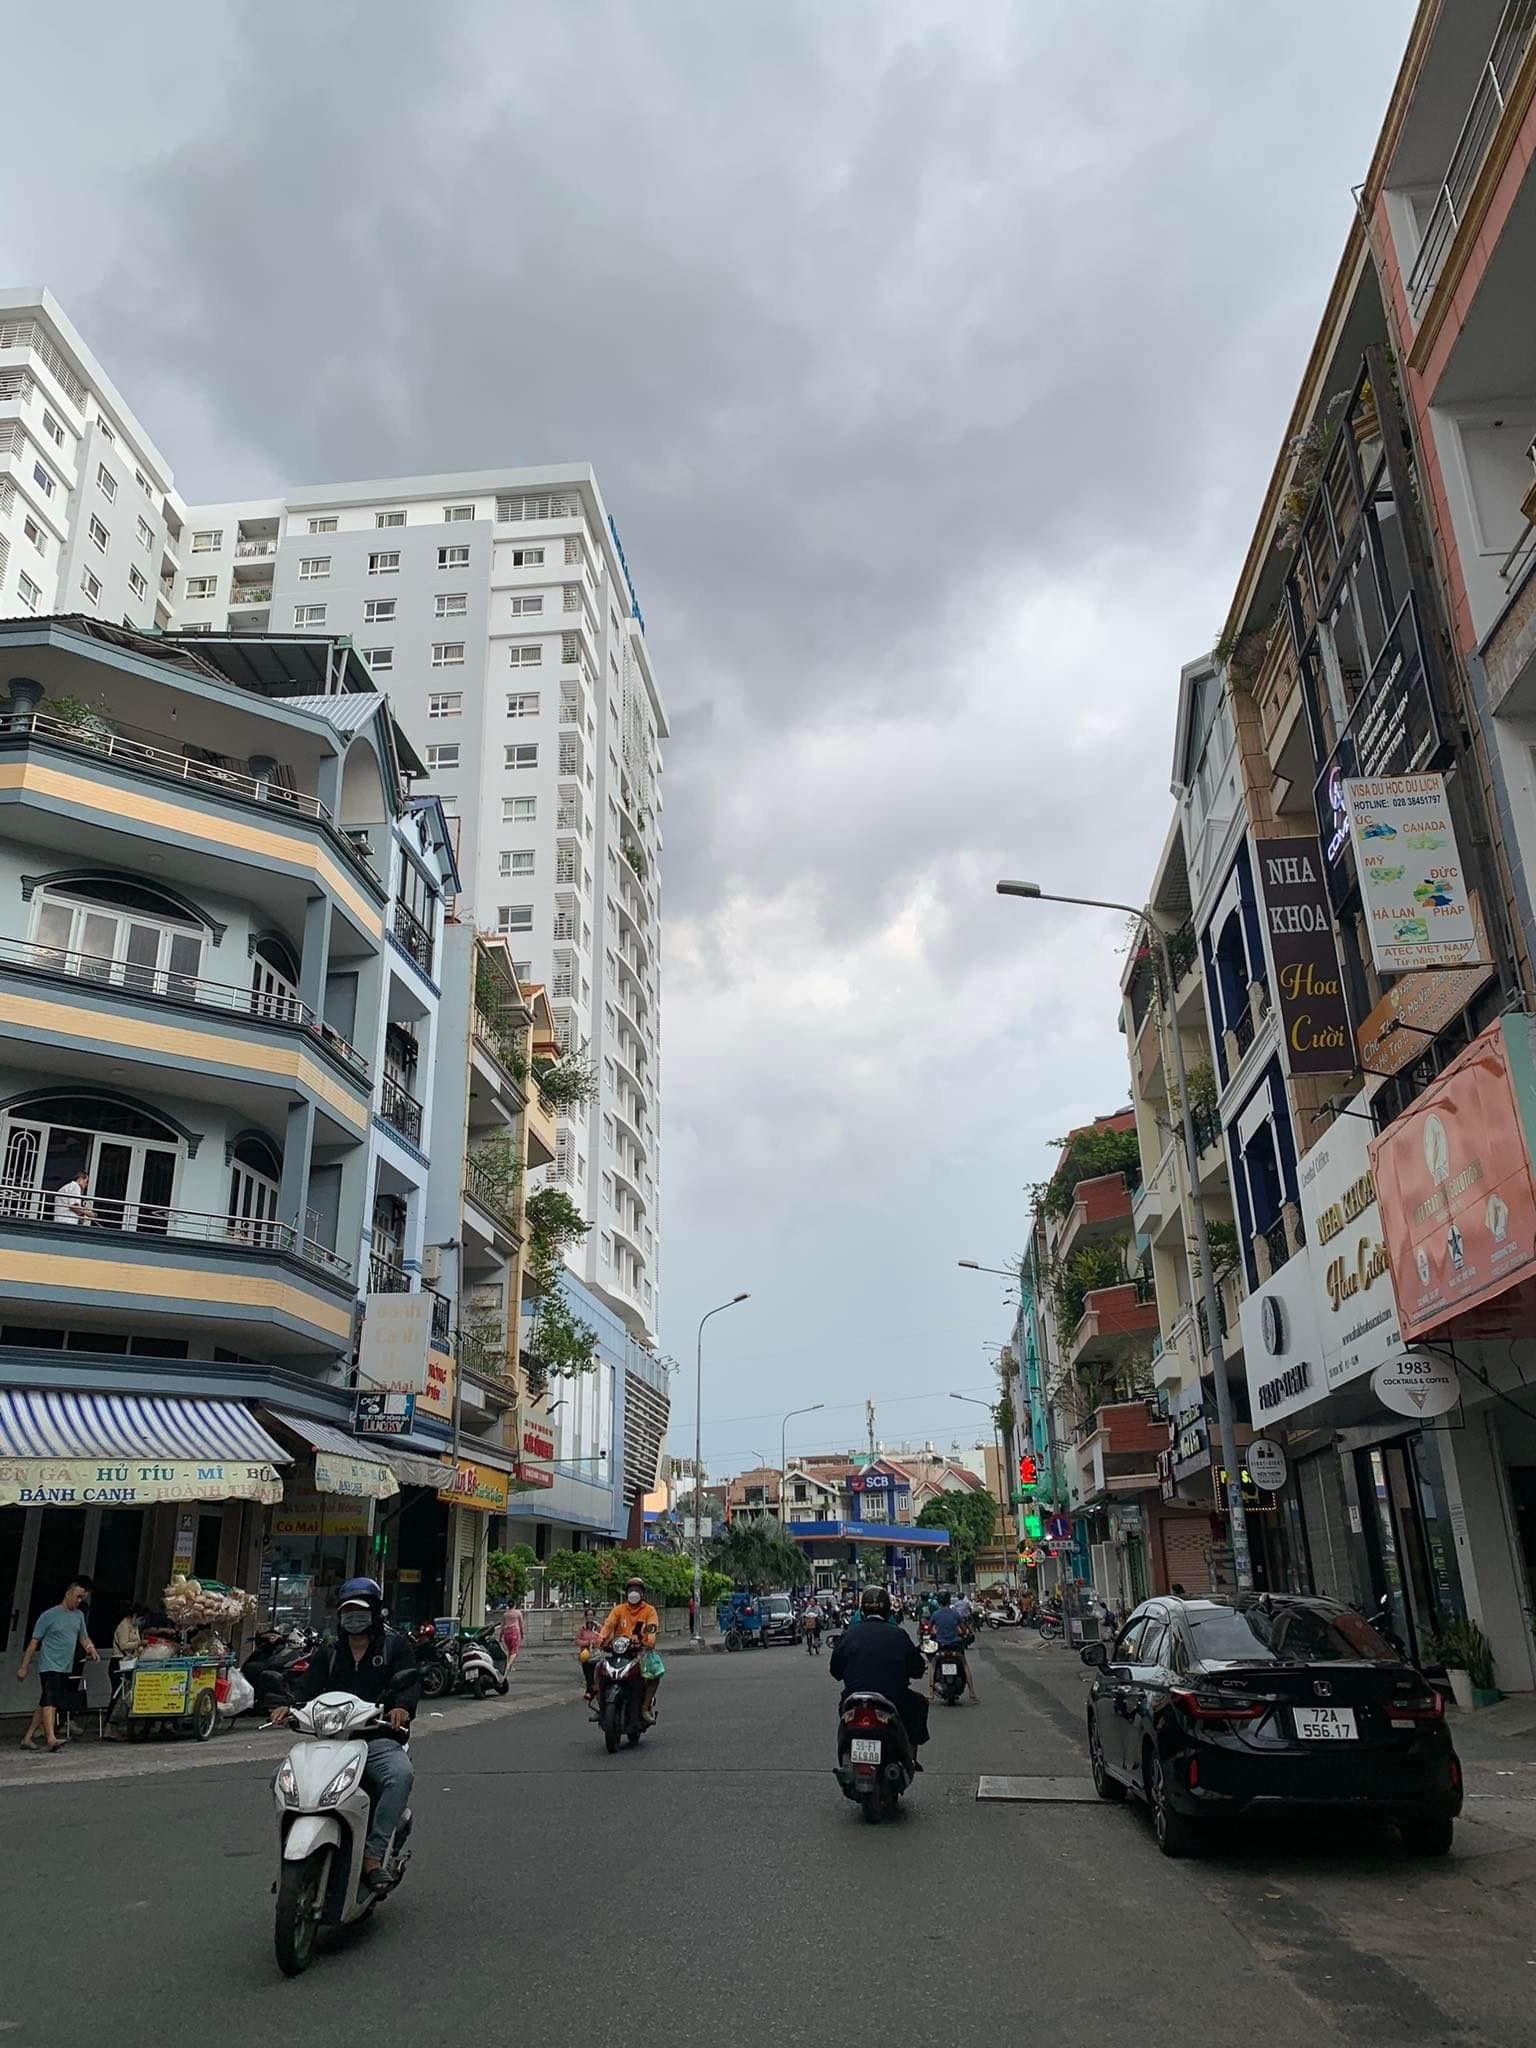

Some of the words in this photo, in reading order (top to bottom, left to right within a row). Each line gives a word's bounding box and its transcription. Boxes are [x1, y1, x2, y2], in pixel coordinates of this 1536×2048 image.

[1353, 799, 1390, 810] HOTLINE:
[1392, 798, 1407, 807] 028
[1408, 794, 1441, 806] 38451797
[1402, 821, 1446, 833] CANADA
[1267, 857, 1317, 885] NHA
[1269, 904, 1329, 934] KHOA
[1391, 907, 1415, 919] LAN
[1384, 946, 1414, 957] ATEC
[1443, 941, 1470, 952] NAM
[1280, 962, 1339, 1001] Hoa
[1291, 1015, 1345, 1051] Cười
[1316, 1202, 1345, 1246] NHA
[1396, 1361, 1432, 1375] 1983
[138, 1464, 175, 1480] TÍU
[866, 1477, 889, 1488] SCB
[20, 1484, 76, 1501] BÁNH
[83, 1488, 136, 1501] CANH
[1312, 1709, 1338, 1722] 72A
[1303, 1724, 1350, 1738] 556.17
